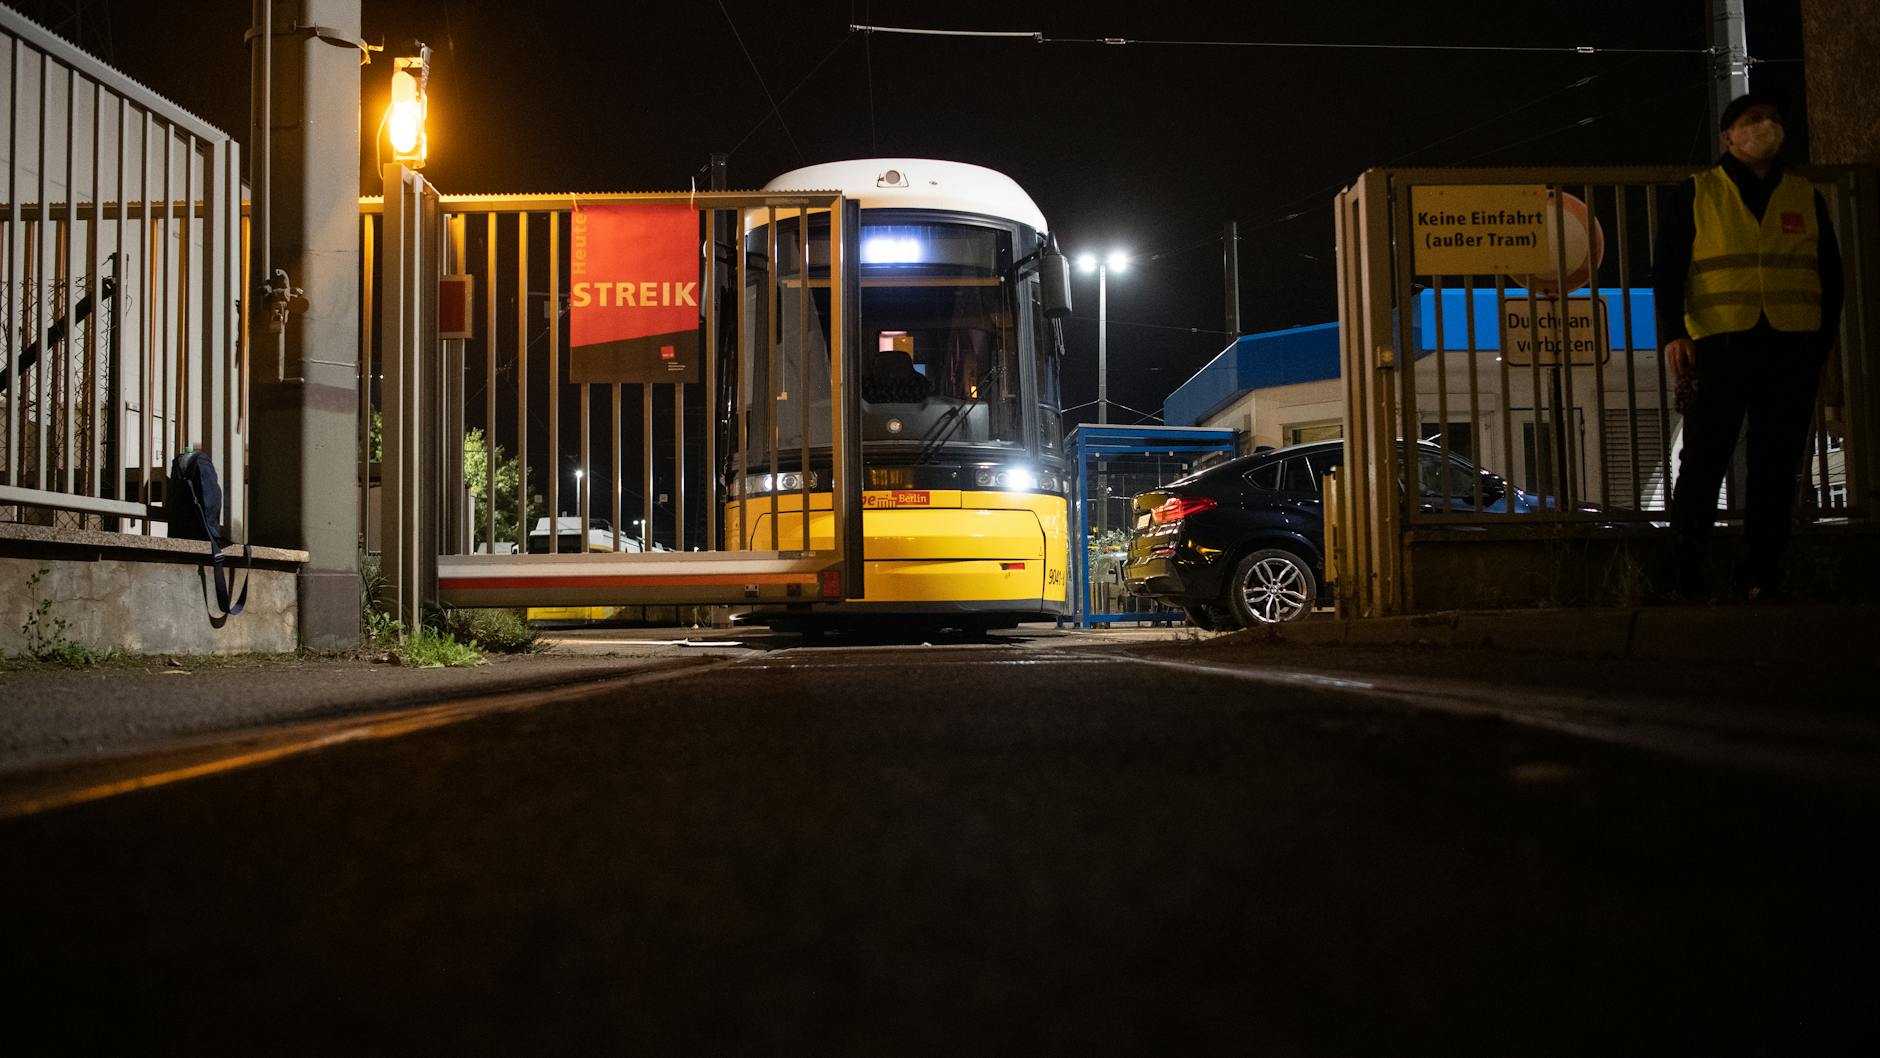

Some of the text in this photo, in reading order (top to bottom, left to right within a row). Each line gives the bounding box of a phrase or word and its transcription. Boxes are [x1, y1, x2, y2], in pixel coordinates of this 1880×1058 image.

[1418, 210, 1543, 226] Keine Einfahrt
[574, 213, 587, 275] Heute
[1425, 232, 1536, 249] (außer Tram)
[573, 282, 697, 307] STREIK
[1508, 312, 1595, 330] Duchan
[899, 493, 927, 503] Berlin
